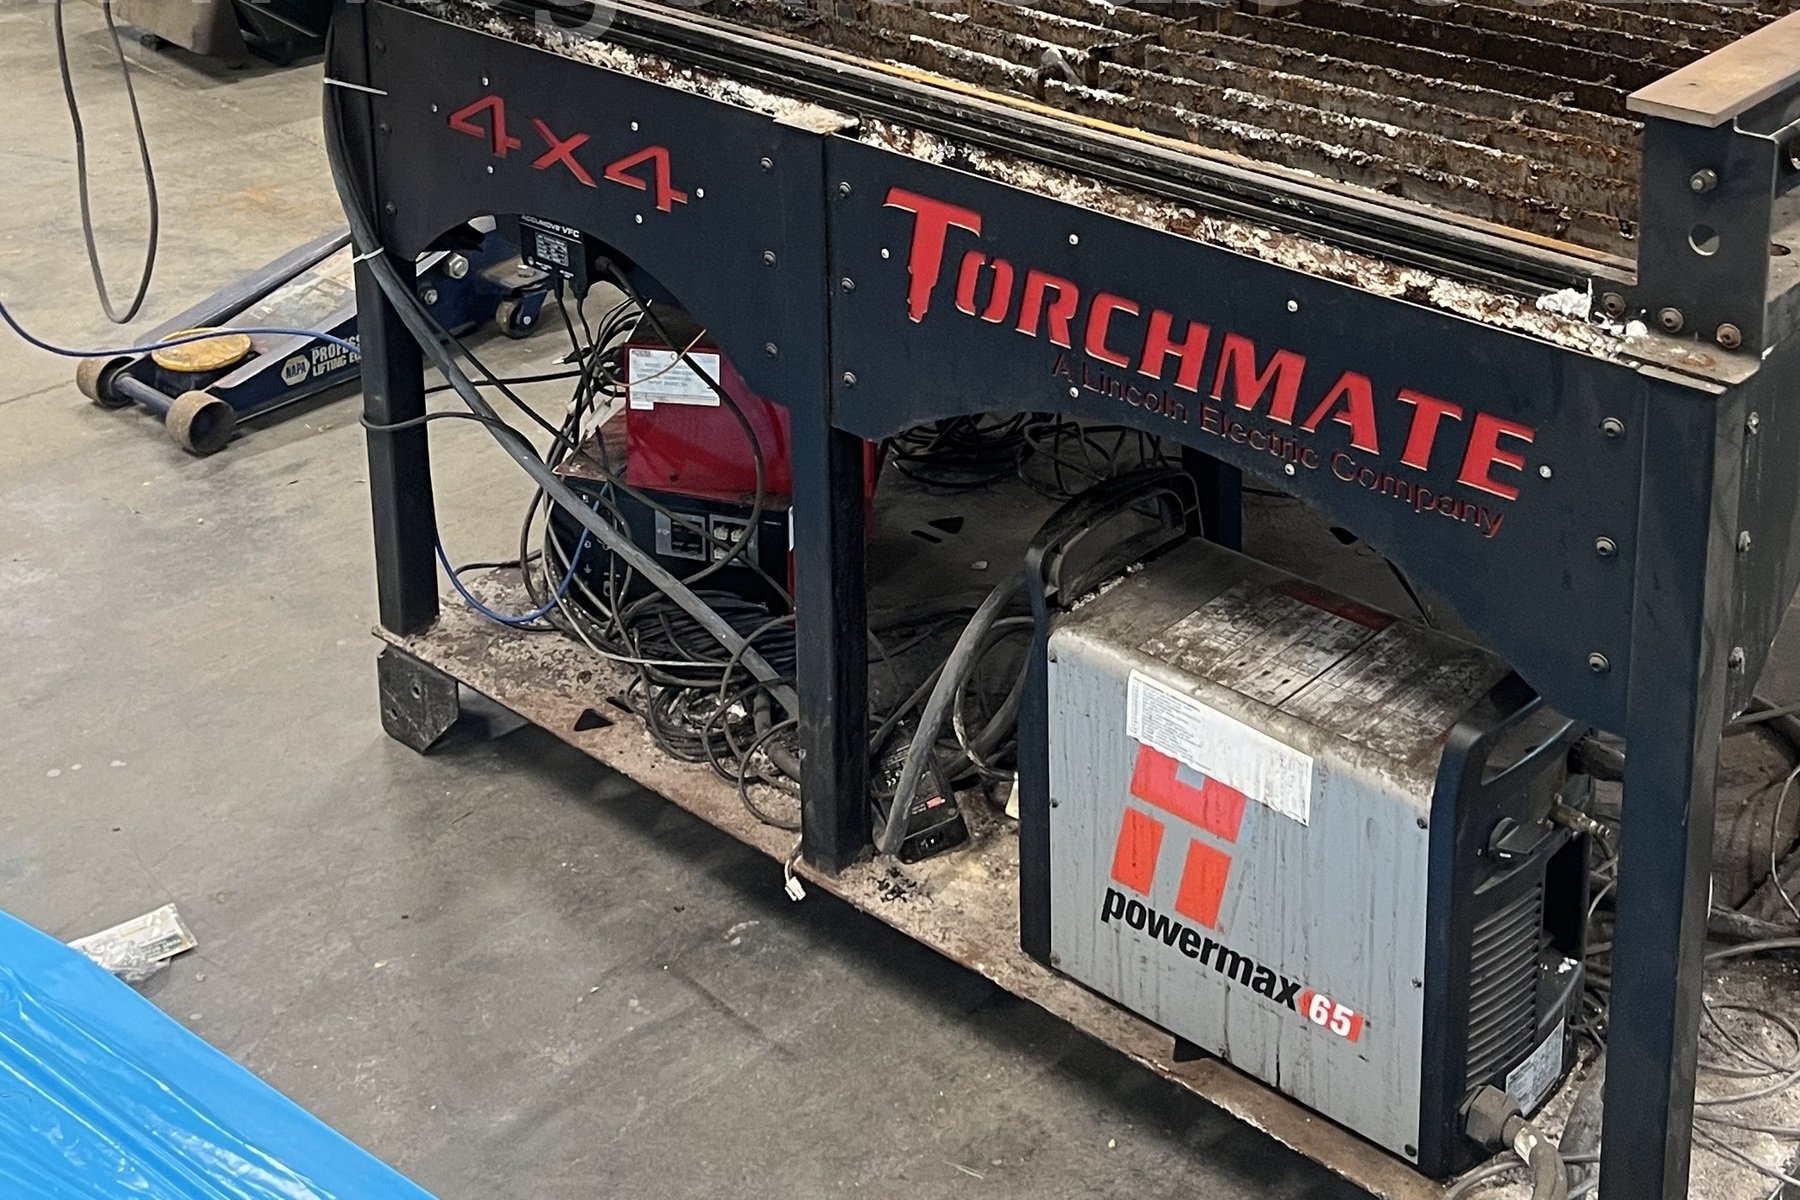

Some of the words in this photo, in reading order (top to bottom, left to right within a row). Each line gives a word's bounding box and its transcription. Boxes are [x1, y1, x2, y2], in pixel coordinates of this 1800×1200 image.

[561, 225, 581, 238] VFC
[286, 361, 306, 380] NAPA
[312, 355, 347, 377] LIFTING
[1051, 353, 1073, 383] A
[1082, 361, 1188, 424] Lincoln
[1200, 403, 1319, 470] Electric
[1330, 451, 1504, 538] Company
[1101, 887, 1302, 1012] powermax
[1308, 994, 1354, 1037] 65
